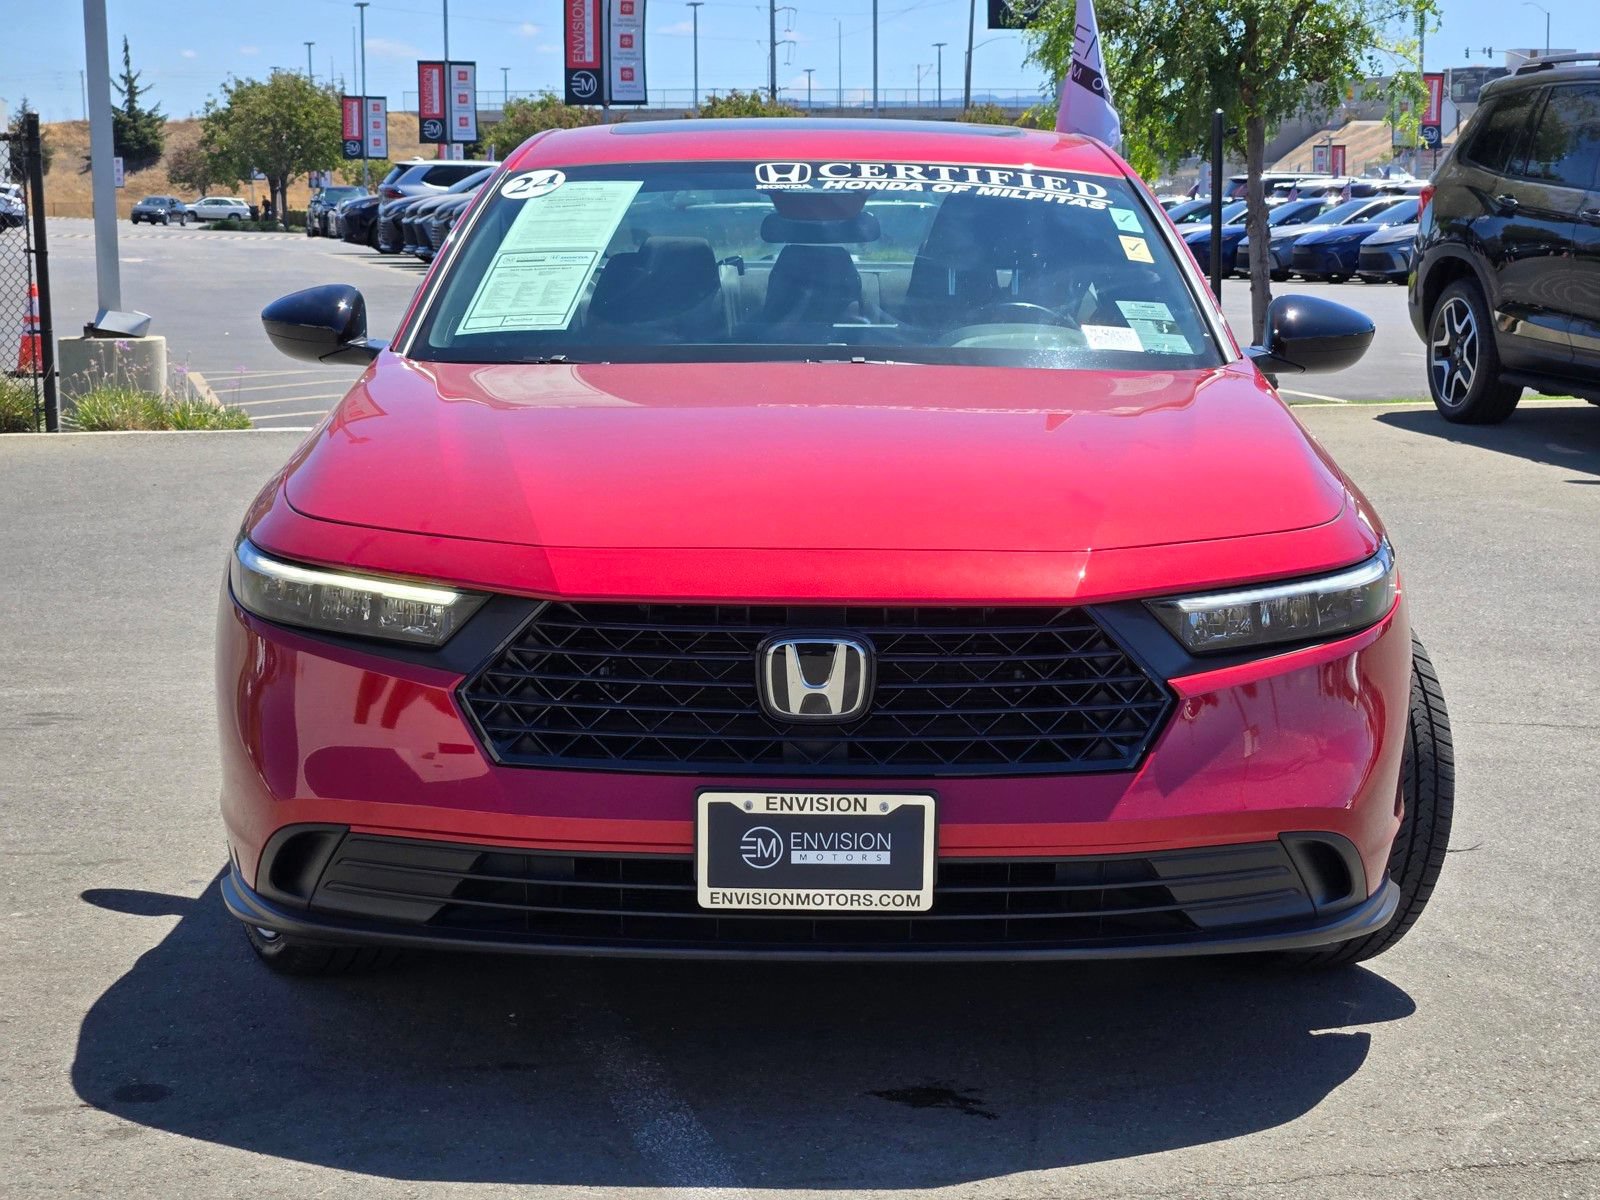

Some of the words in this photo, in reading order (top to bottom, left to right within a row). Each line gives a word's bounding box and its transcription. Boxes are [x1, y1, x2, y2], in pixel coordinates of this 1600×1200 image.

[507, 172, 560, 195] 24
[818, 163, 1108, 199] CERTIFIED
[822, 180, 924, 192] HONDA
[932, 184, 972, 194] OF
[976, 187, 1107, 210] MILPITAS
[765, 796, 868, 812] ENVISION
[790, 832, 892, 850] ENVISION
[799, 853, 883, 862] MOTORS
[709, 892, 921, 907] ENVISIONMOTORS.COM
